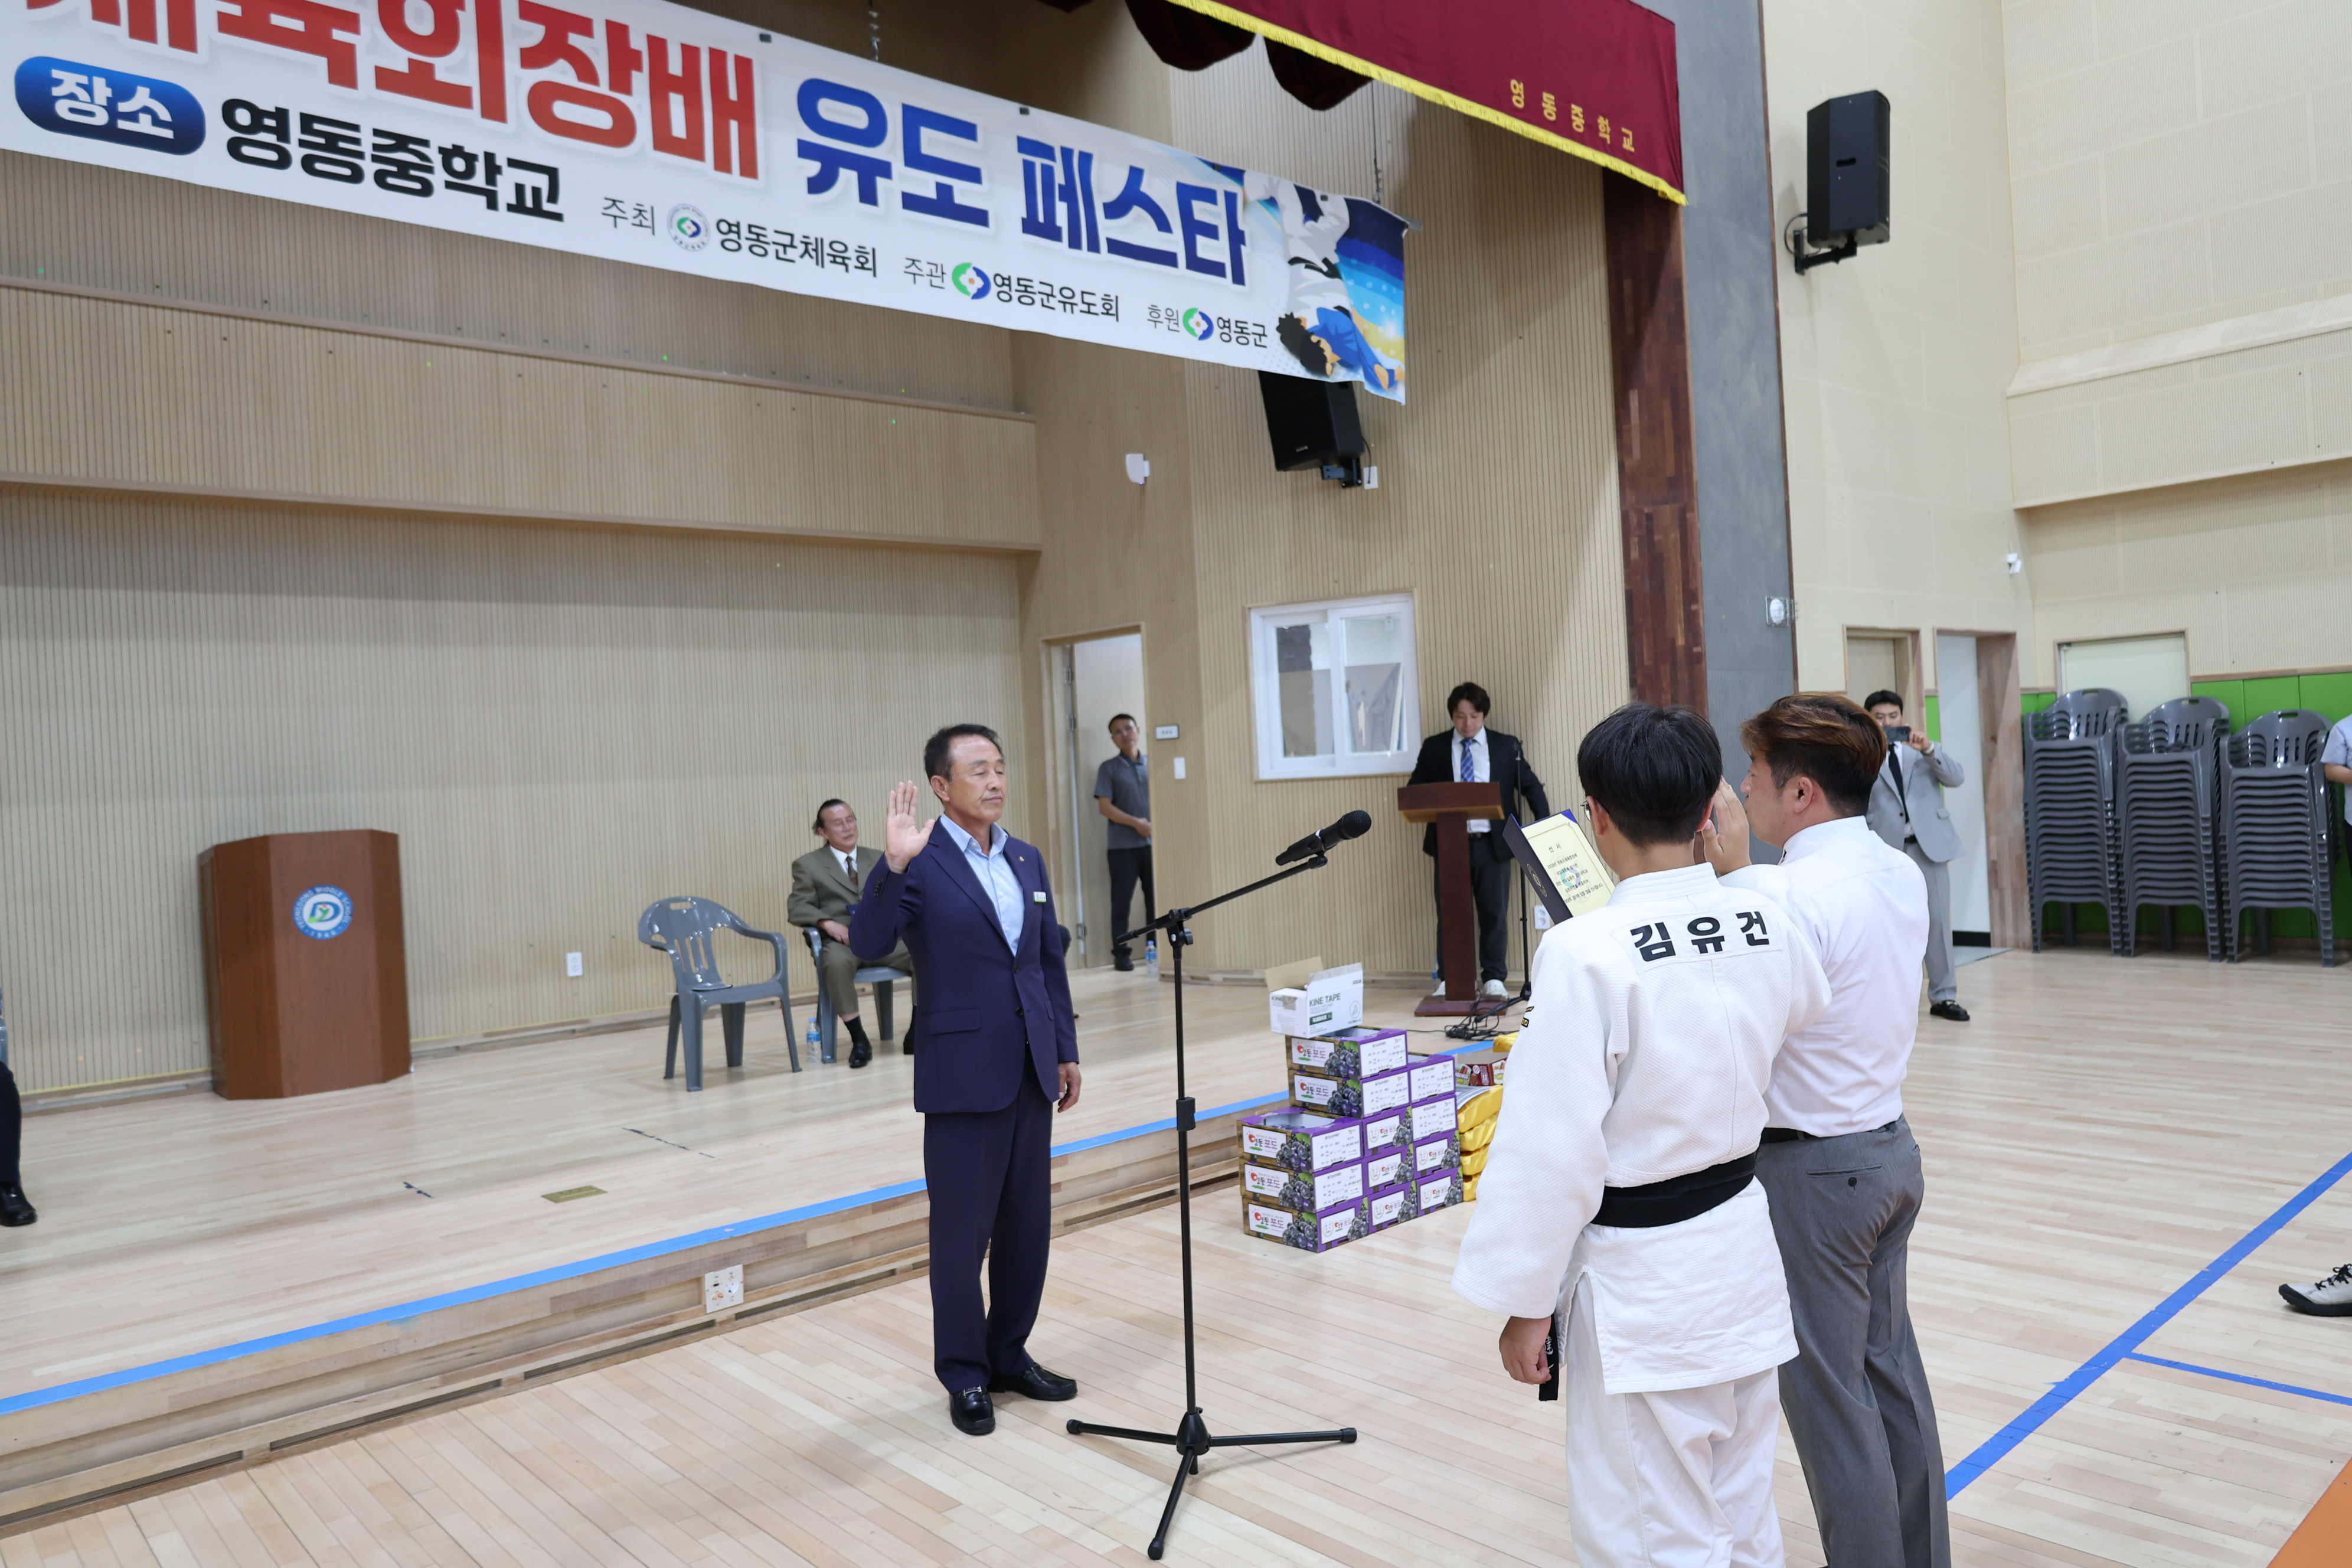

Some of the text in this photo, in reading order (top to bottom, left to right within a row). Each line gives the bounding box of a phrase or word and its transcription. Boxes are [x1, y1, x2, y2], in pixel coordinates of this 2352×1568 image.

[51, 68, 564, 223] 장소 영동중학교
[797, 77, 990, 228] 유도
[1016, 135, 1247, 287] 페스타
[601, 196, 656, 236] 주최
[716, 217, 877, 277] 영동군체육회
[903, 256, 947, 290] 주관
[993, 273, 1120, 322] 영동군유도회
[1146, 303, 1180, 333] 후원
[1216, 317, 1268, 349] 영동군
[1630, 911, 1770, 962] 김유건
[1309, 992, 1341, 1007] KINE TAPE
[1313, 1049, 1326, 1059] 포도
[1316, 1087, 1329, 1097] 포도
[1265, 1139, 1278, 1149] 포도
[1266, 1178, 1280, 1188] 포도
[1270, 1218, 1284, 1229] 포도
